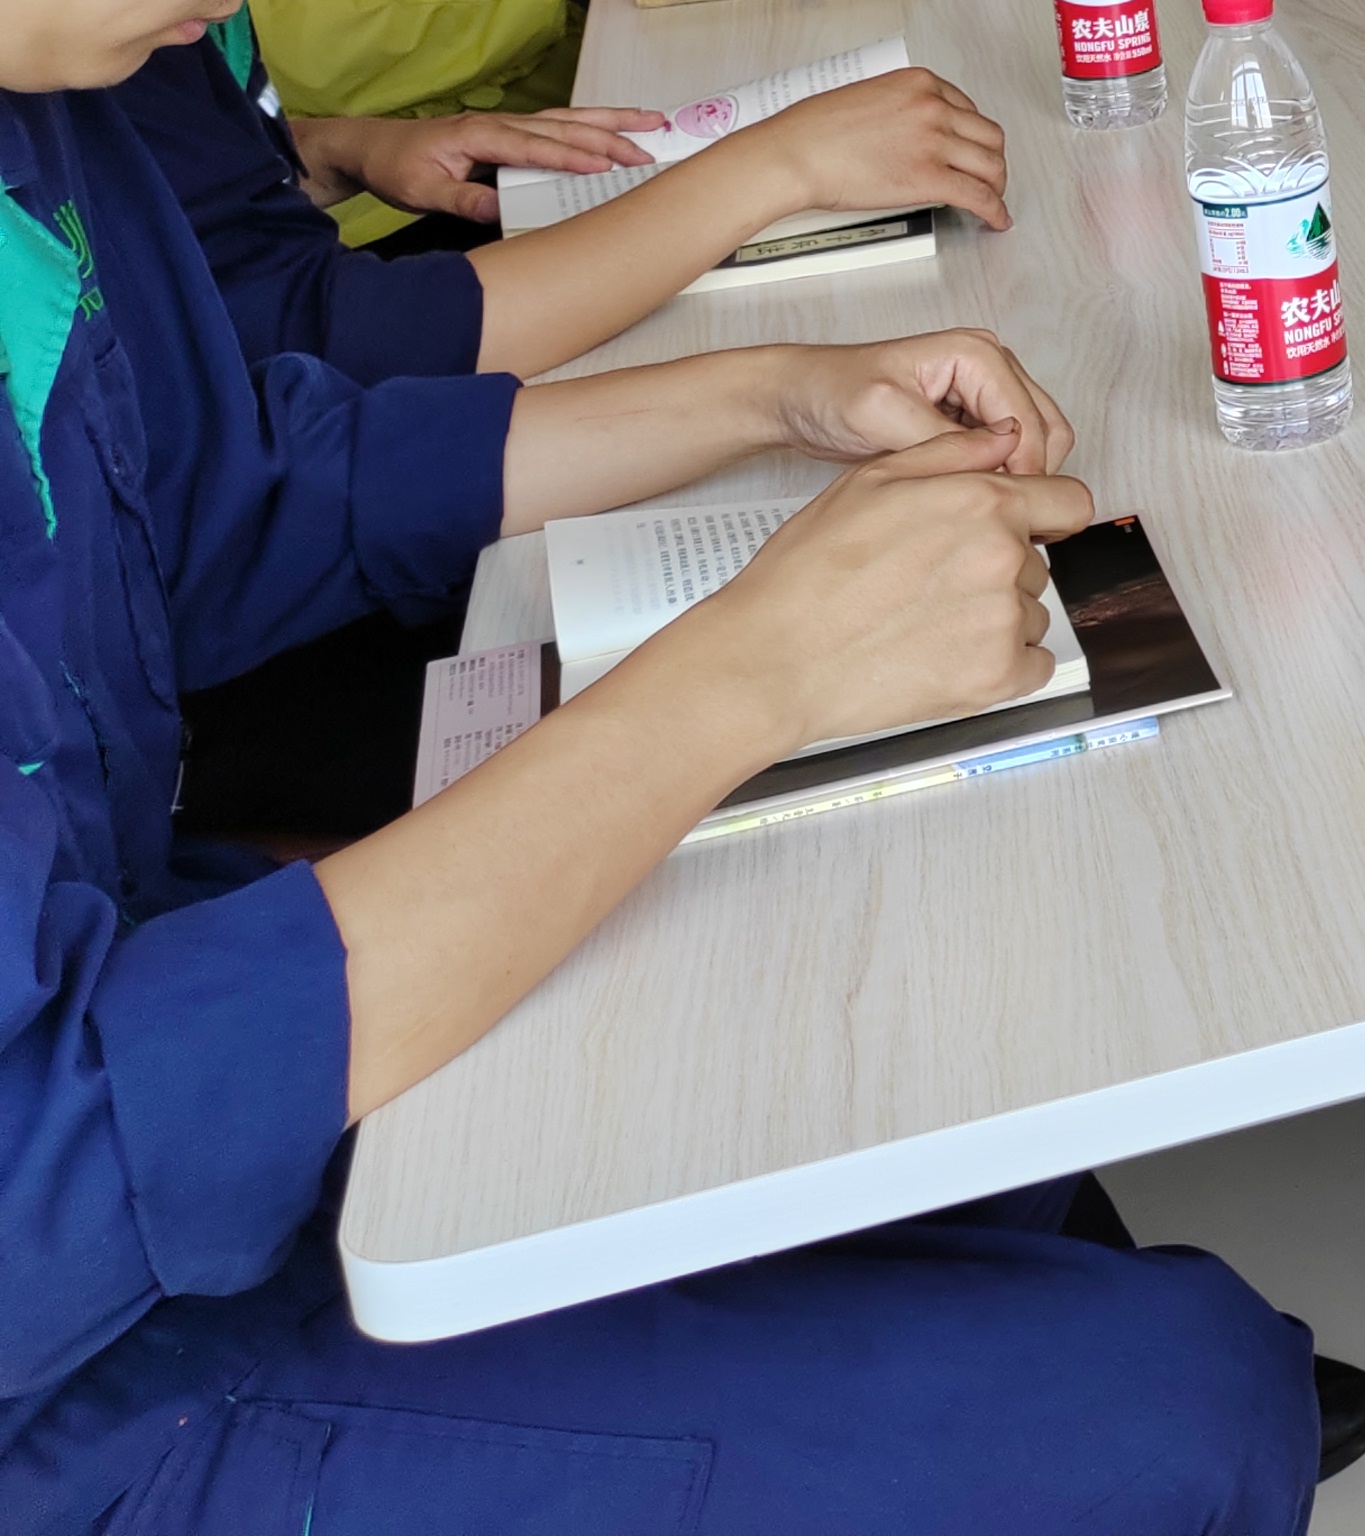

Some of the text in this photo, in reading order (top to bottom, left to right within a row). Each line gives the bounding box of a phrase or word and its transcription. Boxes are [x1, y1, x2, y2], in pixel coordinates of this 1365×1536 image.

[1072, 10, 1150, 40] 农夫山泉
[1074, 32, 1152, 53] NONGFU SPRING
[1284, 319, 1332, 345] NONGFU
